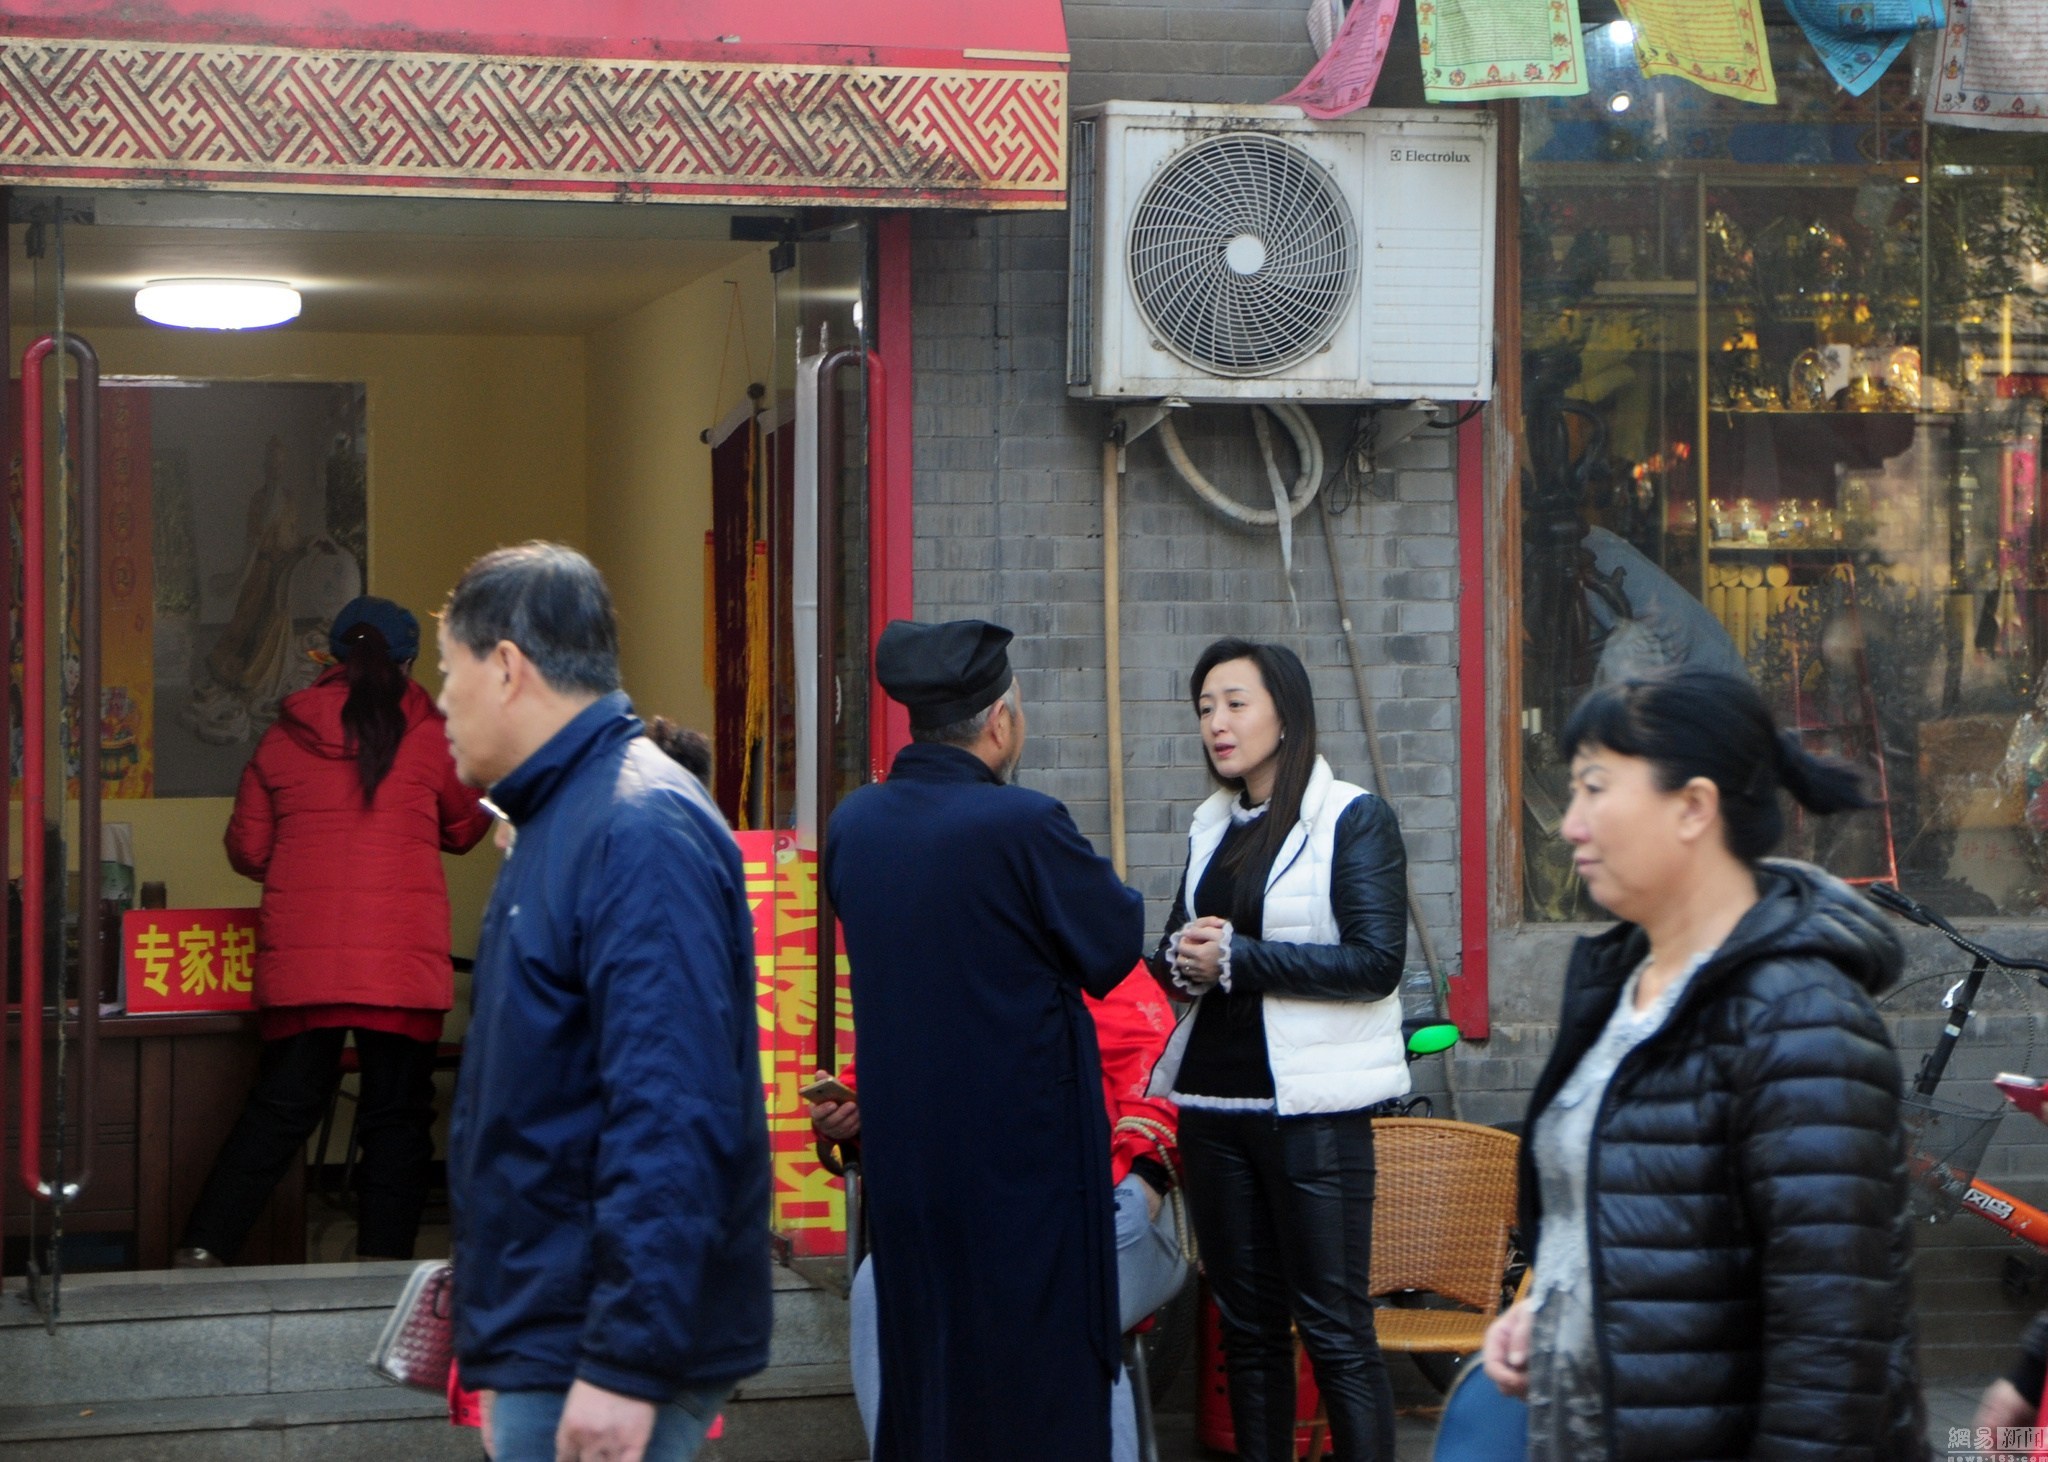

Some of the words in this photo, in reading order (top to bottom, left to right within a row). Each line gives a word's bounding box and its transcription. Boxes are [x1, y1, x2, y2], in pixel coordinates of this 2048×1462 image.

[1406, 150, 1471, 163] Electrolux
[134, 923, 256, 997] 专家起
